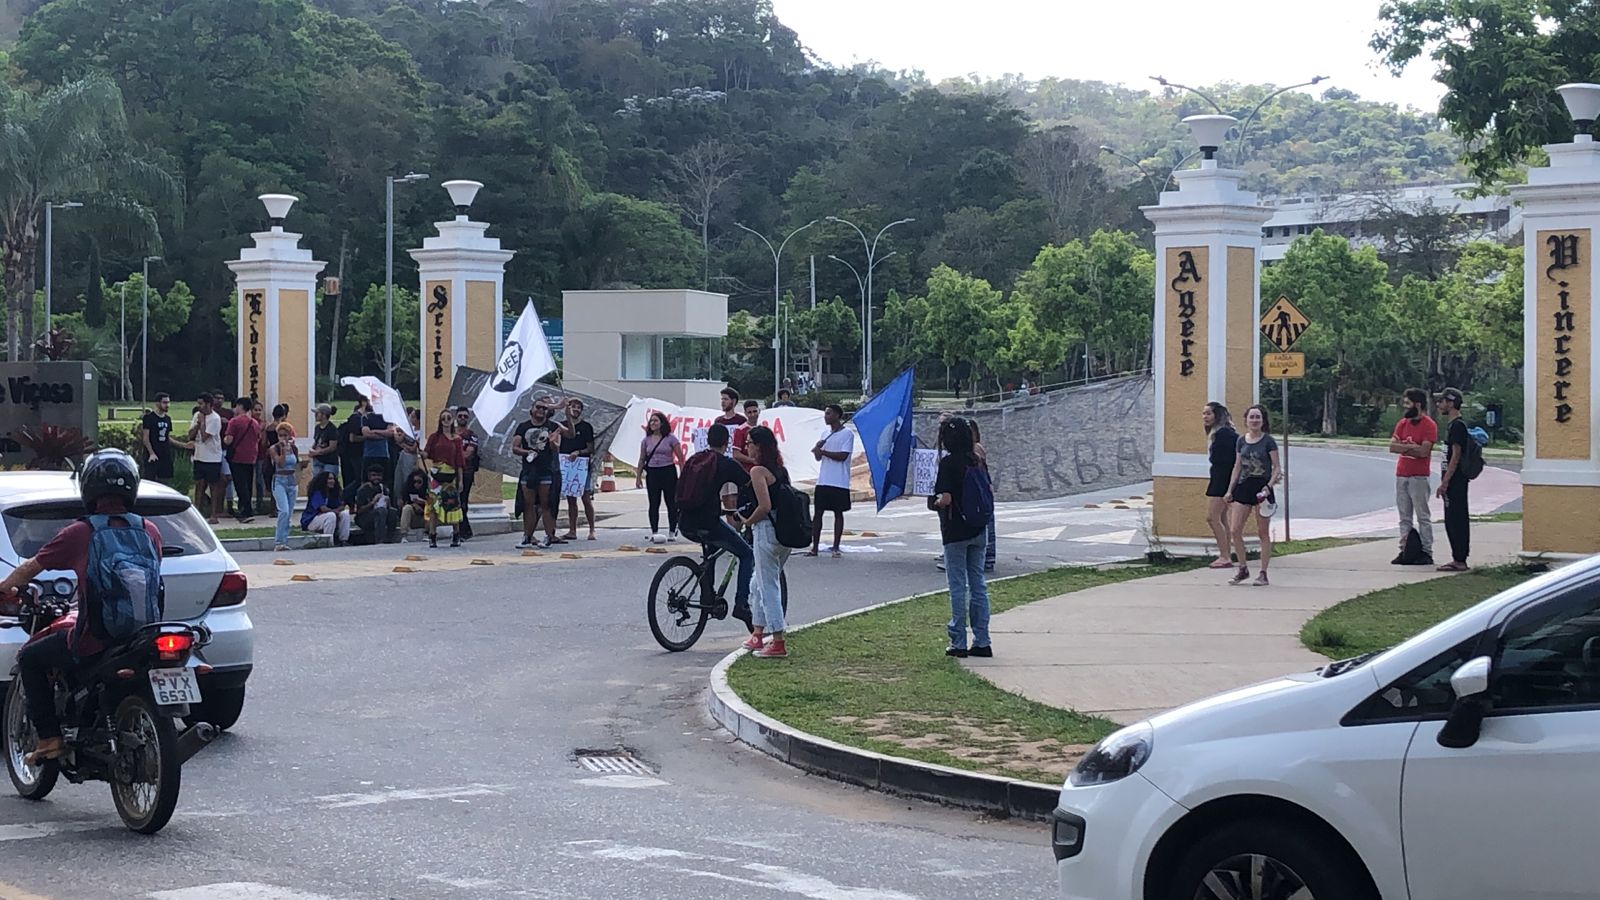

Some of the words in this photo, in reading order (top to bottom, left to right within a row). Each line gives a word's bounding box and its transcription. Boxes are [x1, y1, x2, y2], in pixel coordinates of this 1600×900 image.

[427, 284, 448, 379] Scire
[1171, 250, 1202, 376] Agere
[1546, 234, 1580, 423] Vincere
[498, 350, 519, 374] UEE
[157, 676, 193, 690] PVX
[159, 688, 195, 703] 6531
